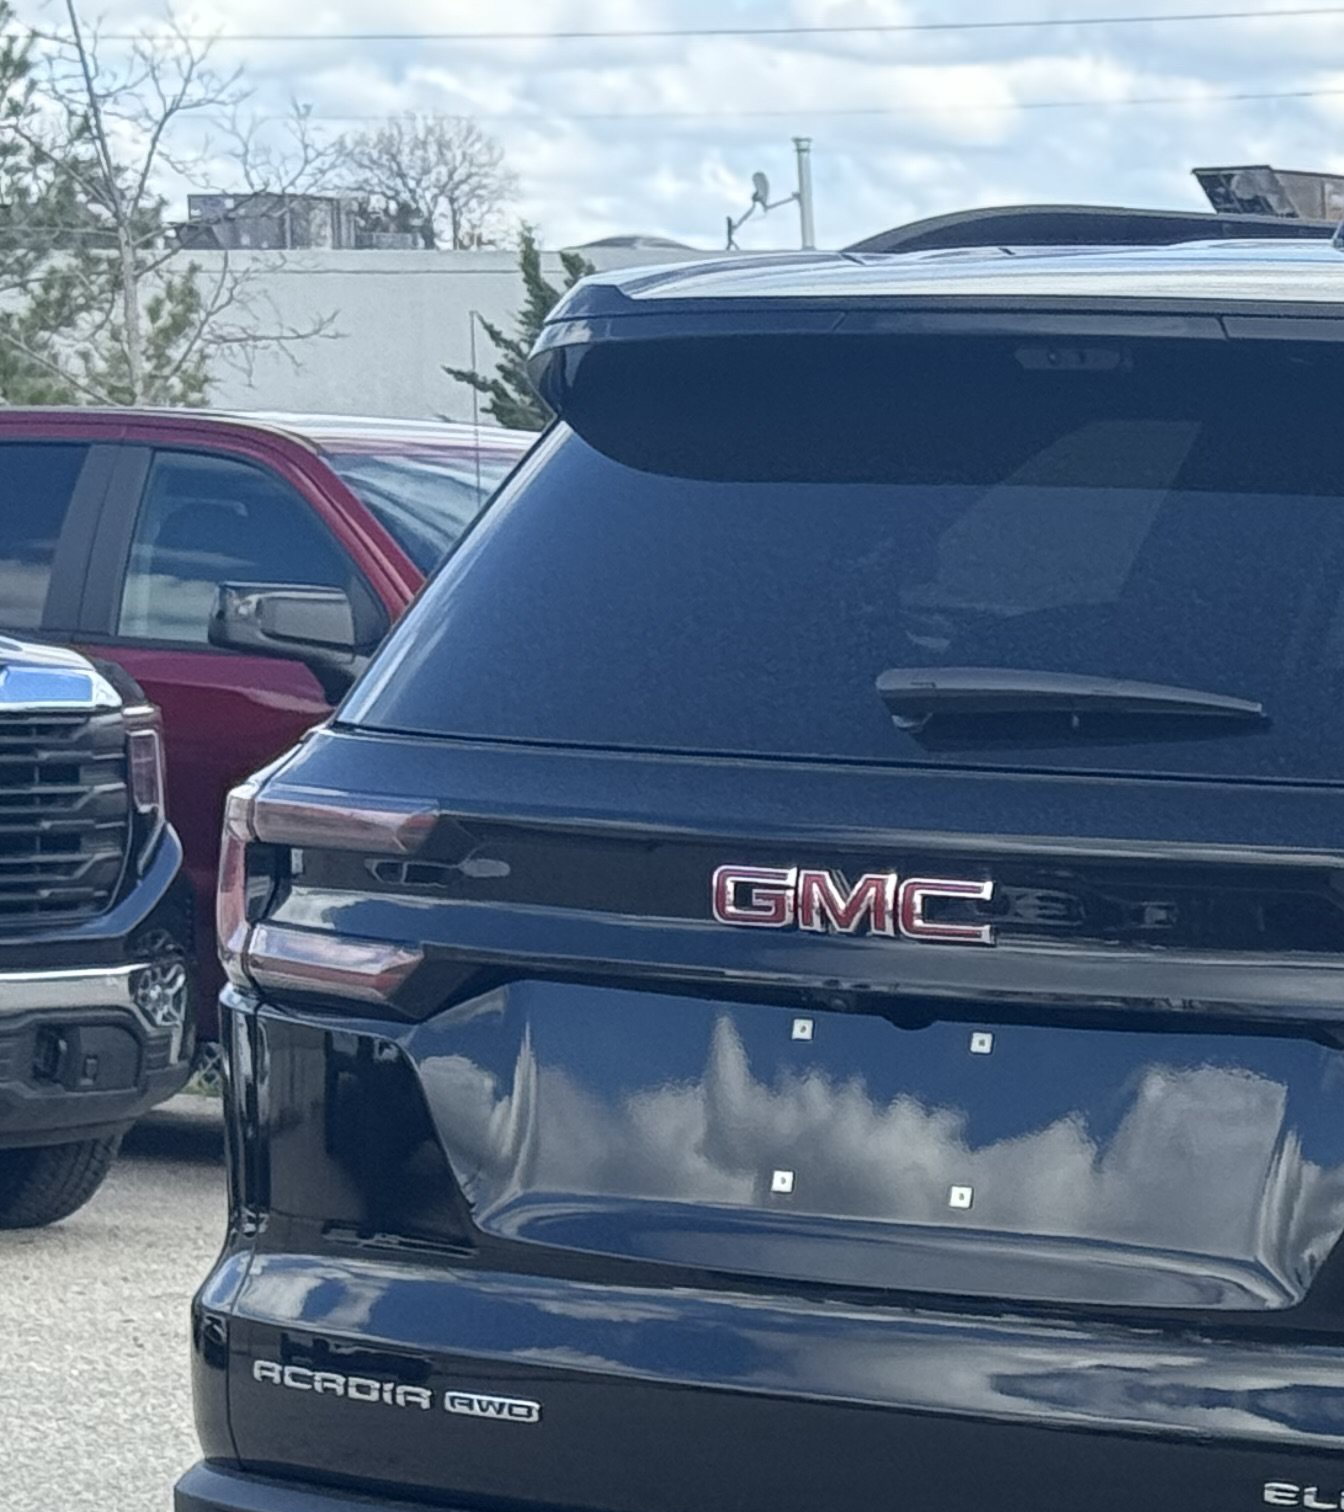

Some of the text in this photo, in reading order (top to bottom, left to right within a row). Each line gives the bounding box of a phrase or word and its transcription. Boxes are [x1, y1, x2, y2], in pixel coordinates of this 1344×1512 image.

[712, 865, 993, 943] GMC
[253, 1360, 539, 1420] ACADIA AWD
